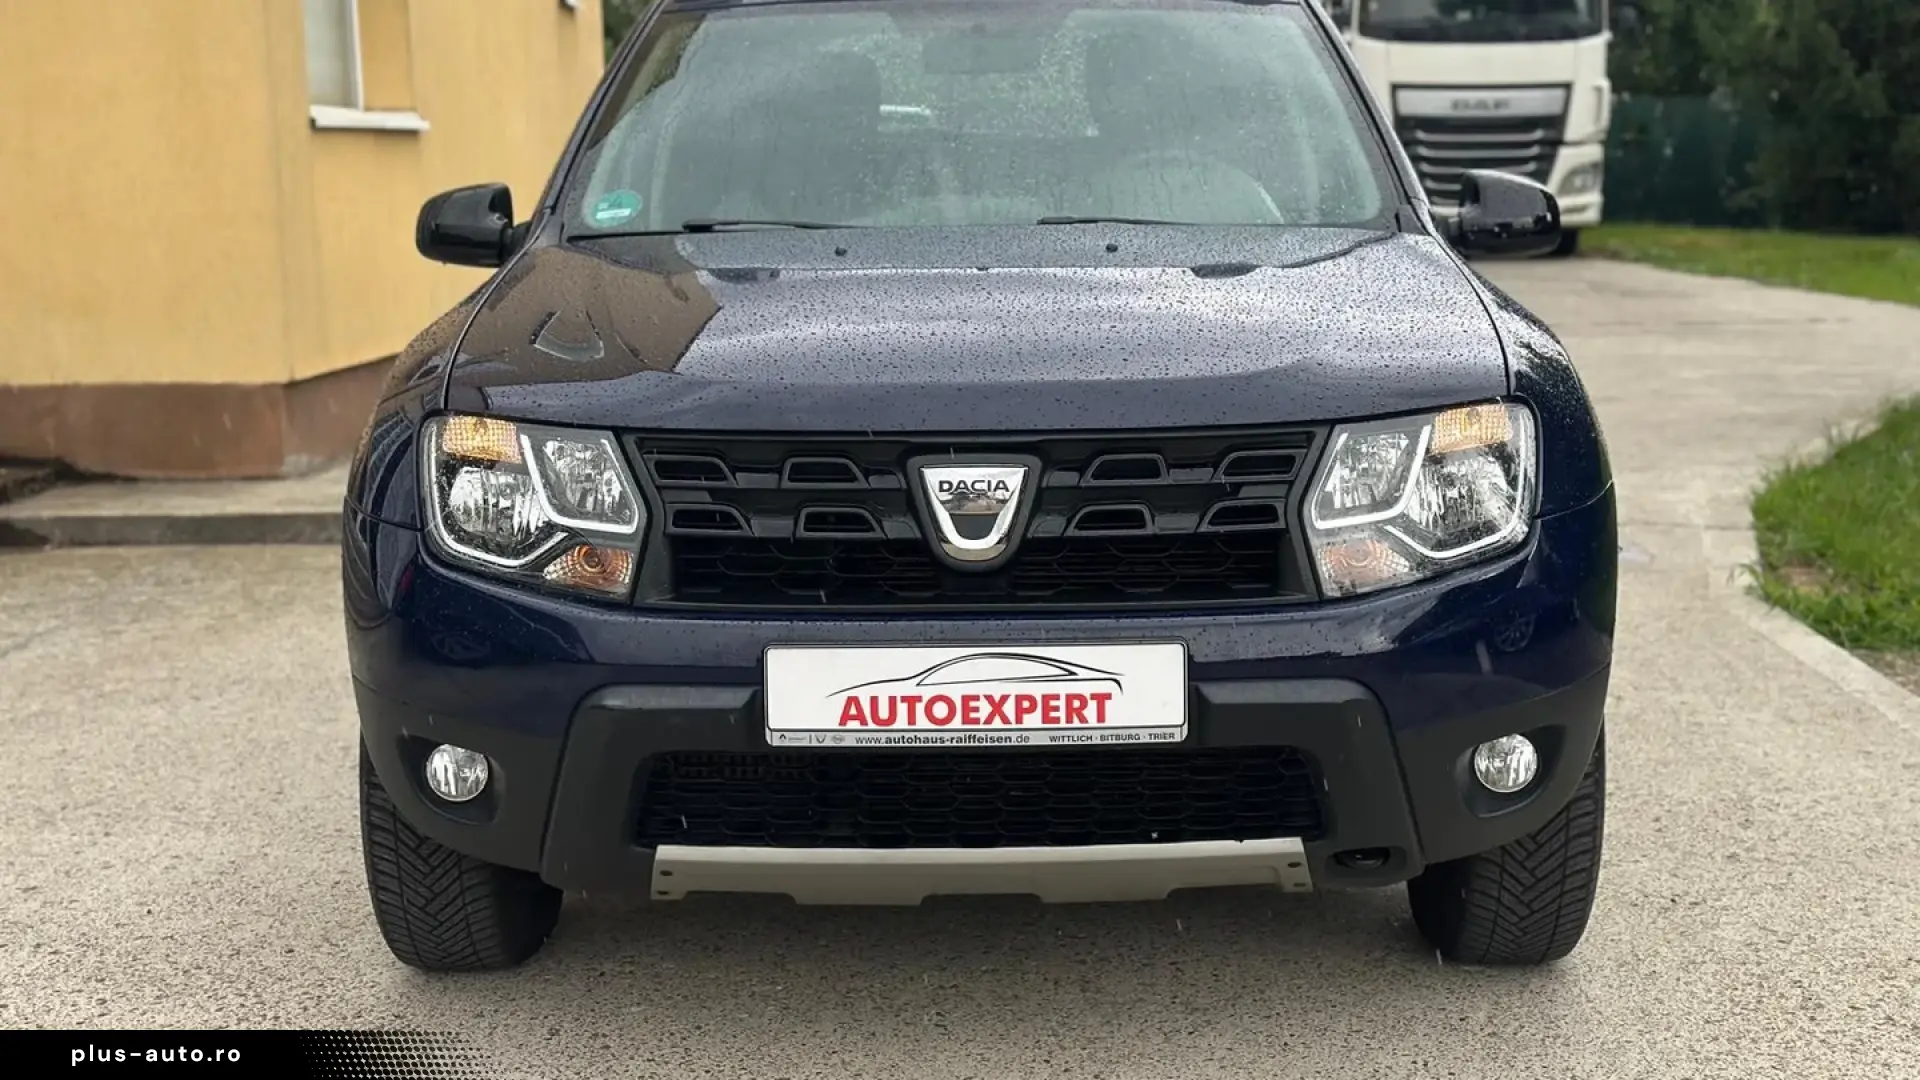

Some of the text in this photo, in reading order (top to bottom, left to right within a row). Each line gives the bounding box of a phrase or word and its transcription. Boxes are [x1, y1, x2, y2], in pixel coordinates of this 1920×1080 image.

[938, 480, 1010, 493] DACIA
[838, 692, 1113, 728] AUTOEXPERT
[855, 734, 1030, 745] www.autohaus-raiffeisen.de
[1049, 732, 1176, 743] WITTLICH BITBURG TRIER
